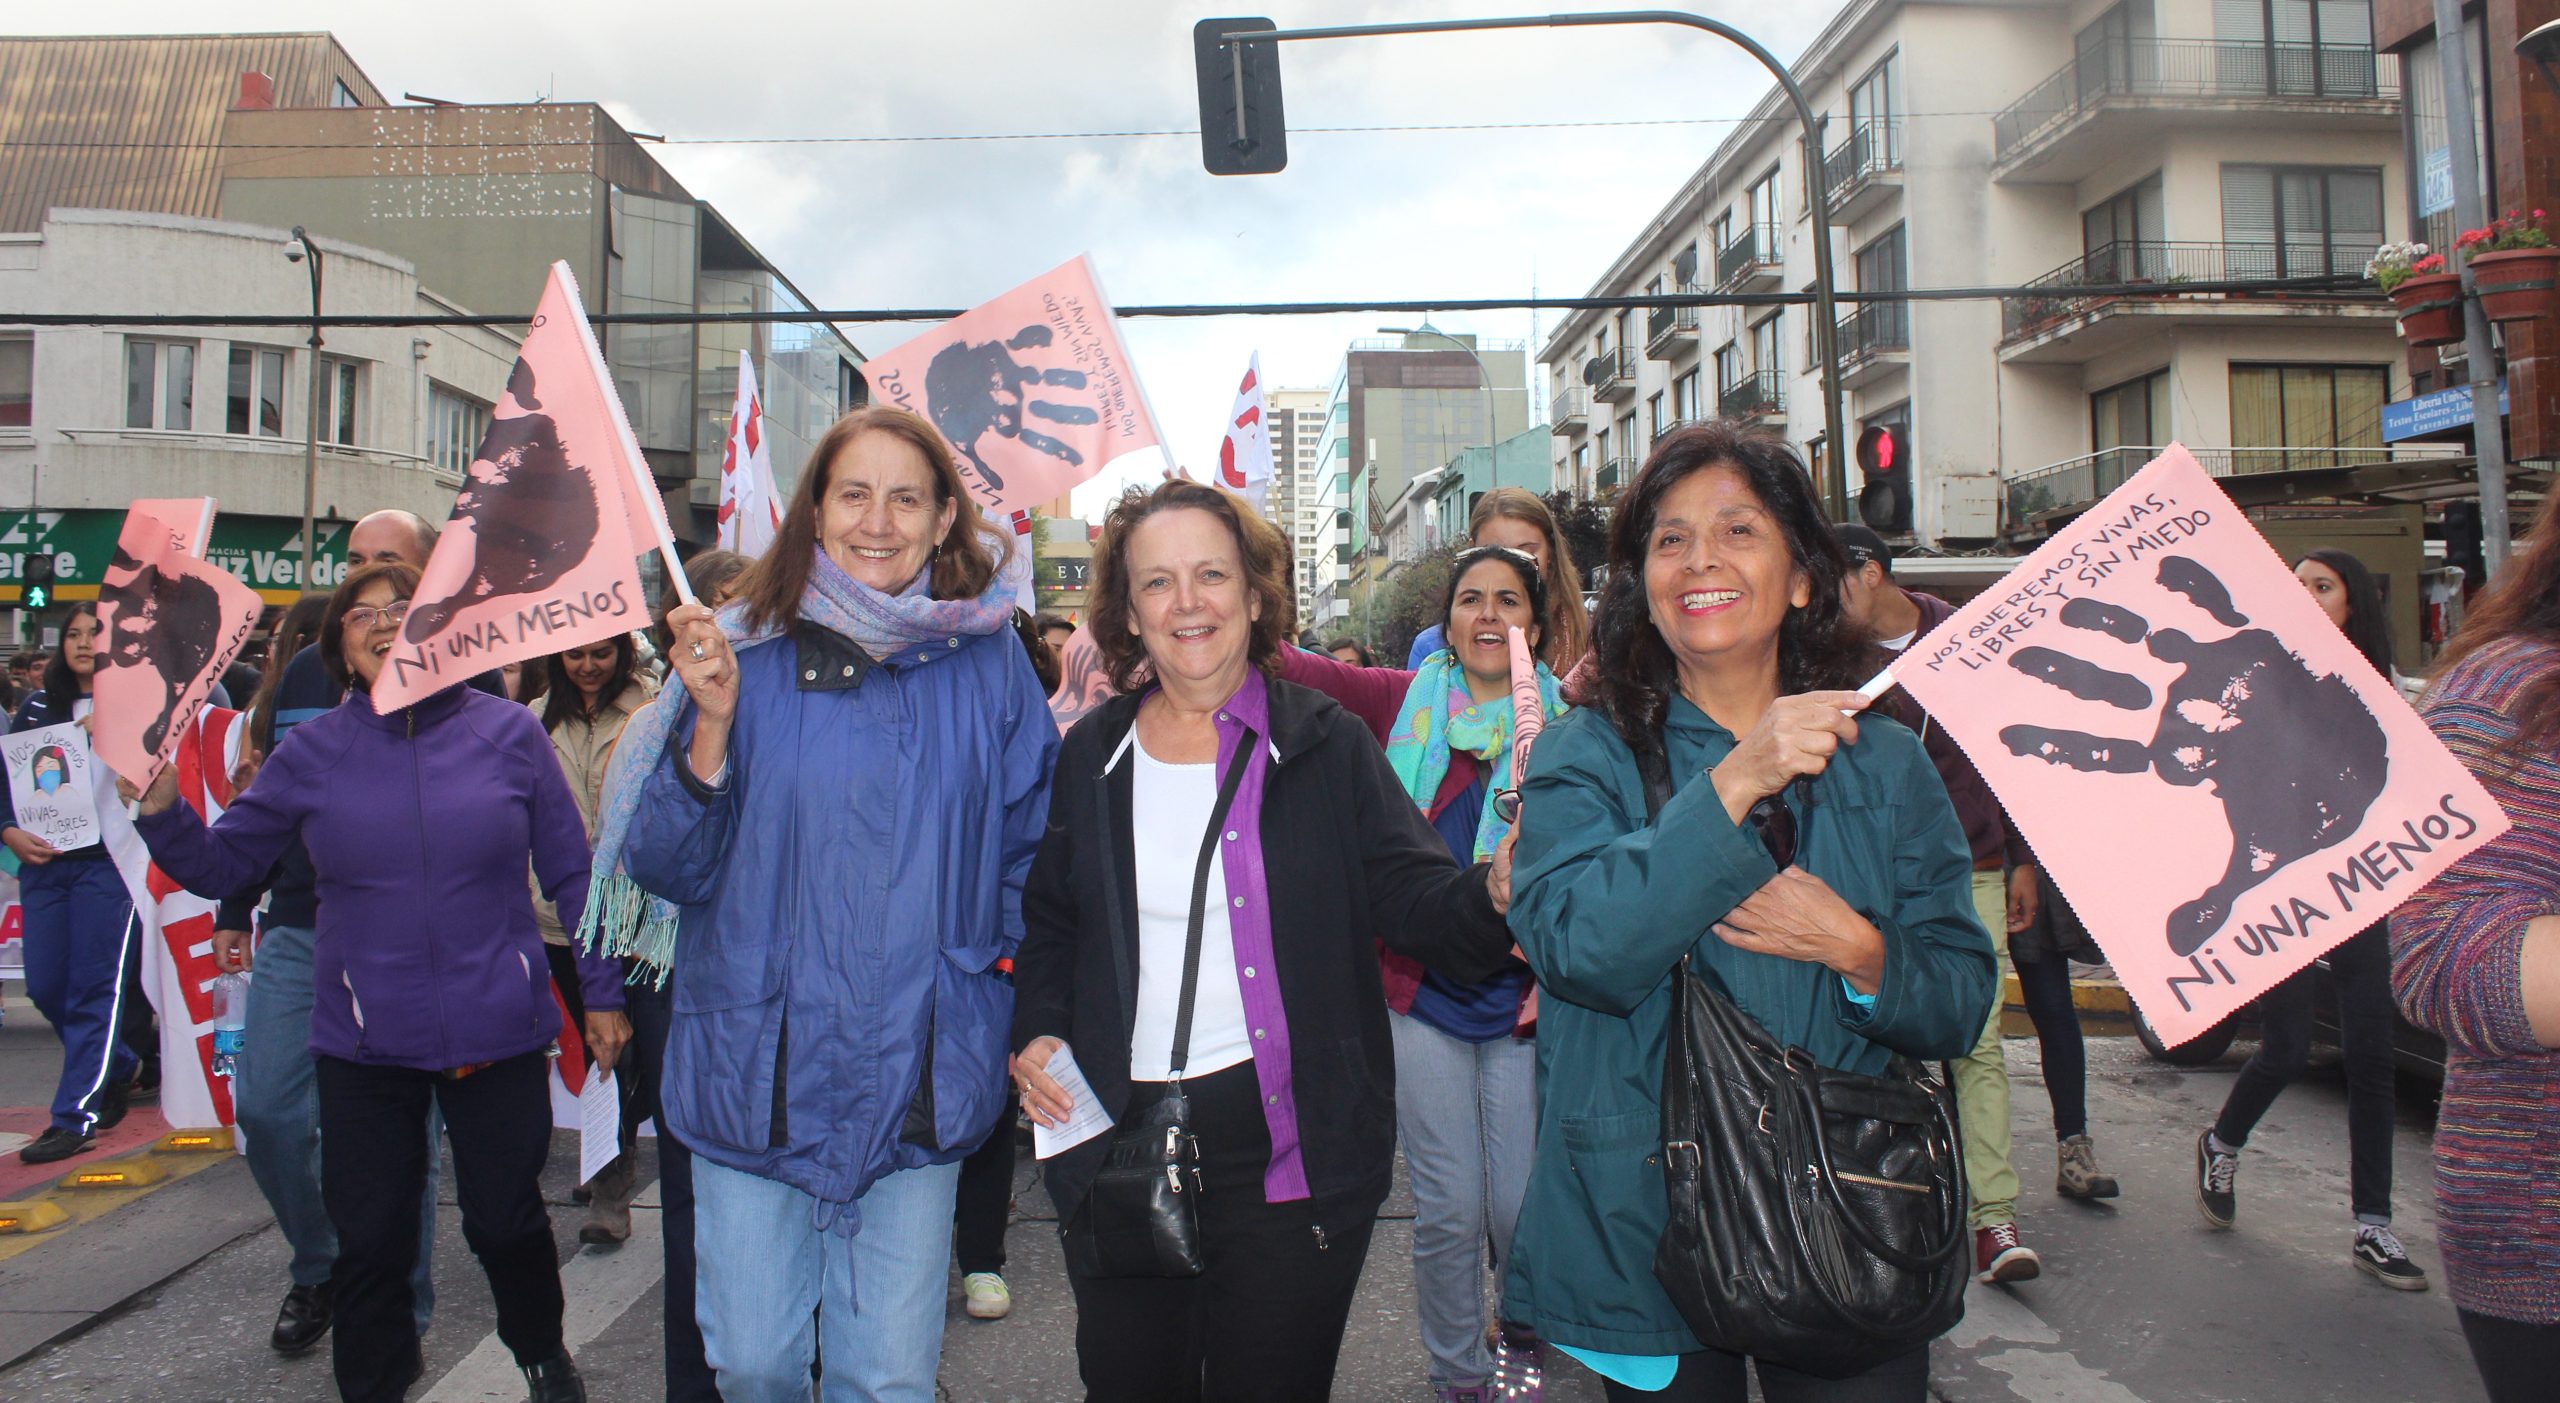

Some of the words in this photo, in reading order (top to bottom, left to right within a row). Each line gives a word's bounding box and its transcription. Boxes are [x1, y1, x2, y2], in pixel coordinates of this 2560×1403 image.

[447, 618, 509, 660] UNA
[515, 579, 631, 644] MENOS
[1926, 632, 1962, 672] NOS
[1968, 542, 2089, 638] QUEREMOS
[2044, 582, 2070, 601] Y
[9, 740, 37, 769] NOS
[2233, 896, 2330, 957] UNA
[2326, 793, 2478, 913] MENOS
